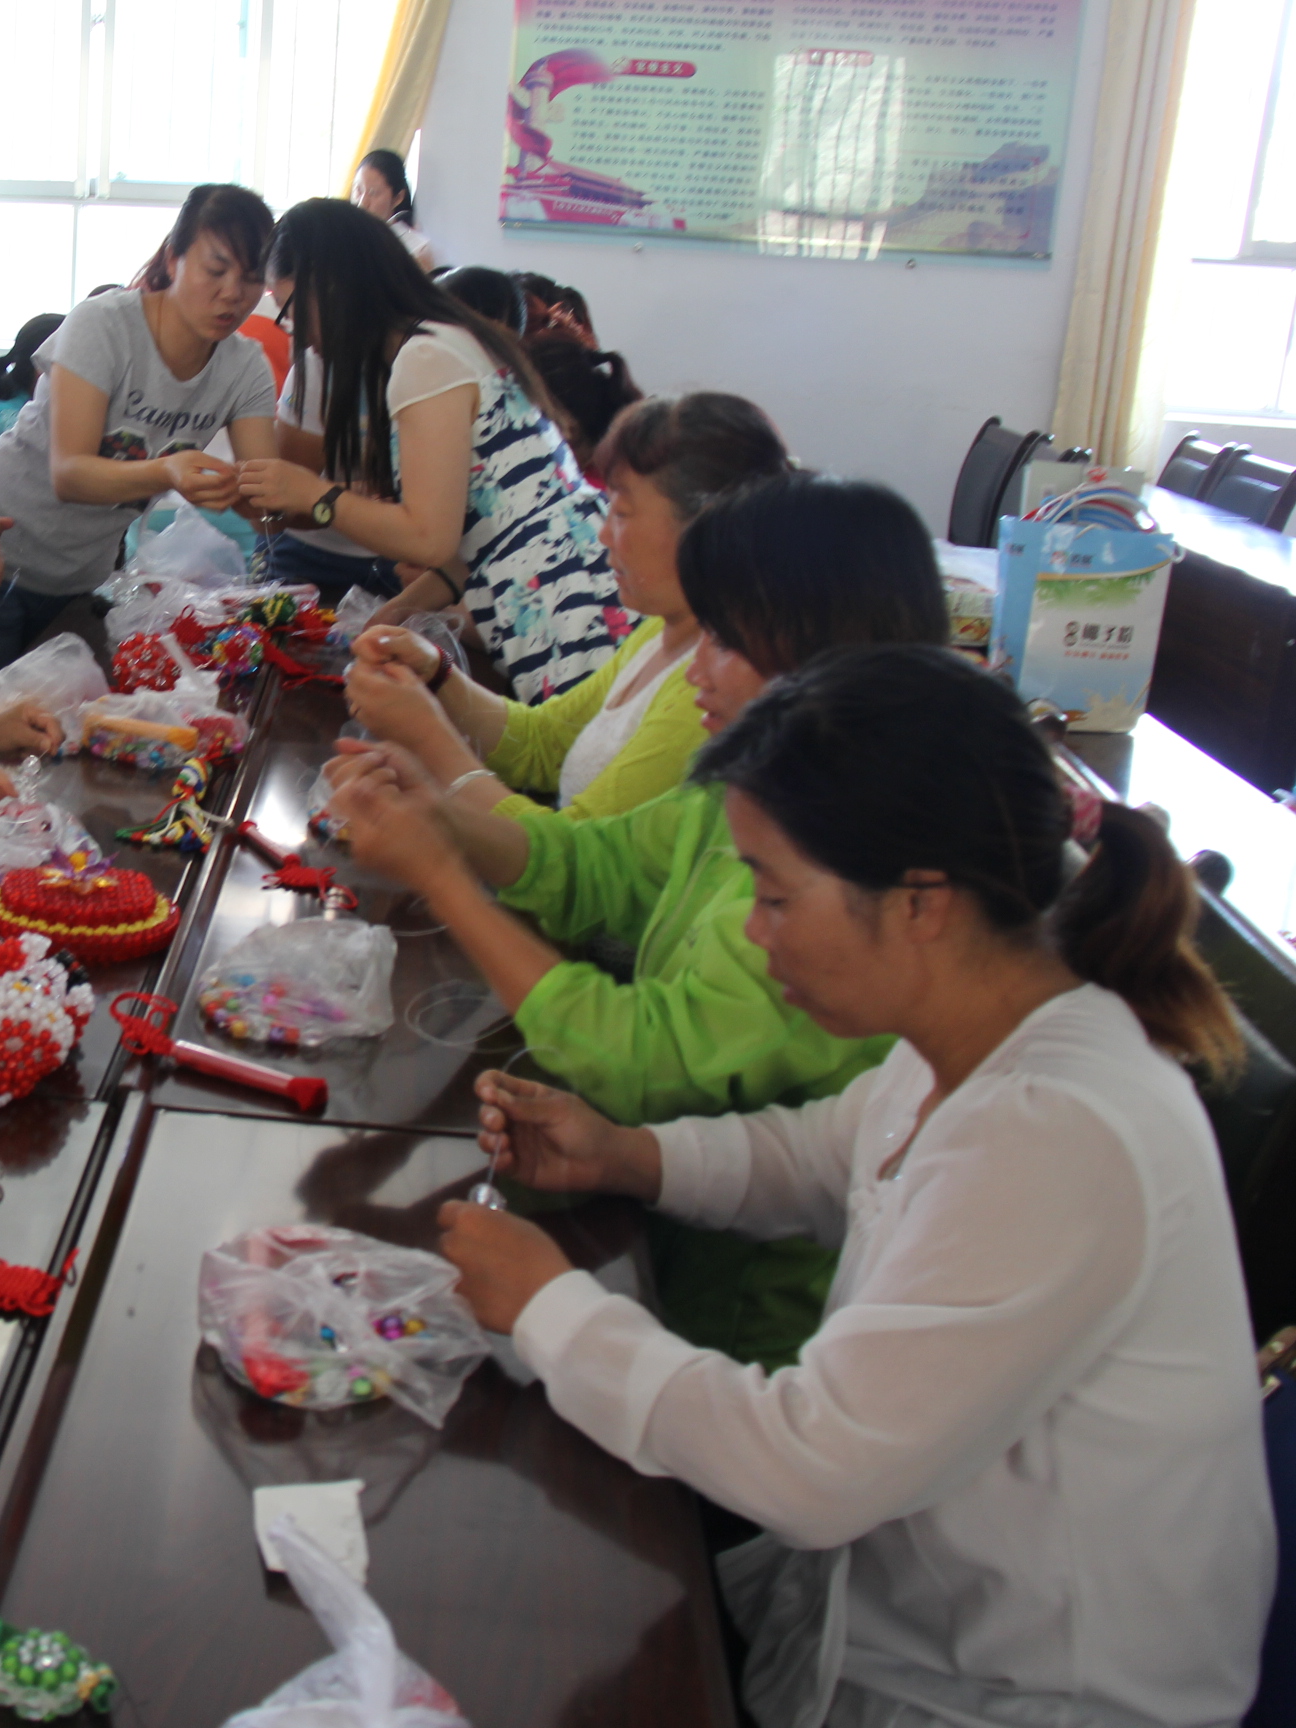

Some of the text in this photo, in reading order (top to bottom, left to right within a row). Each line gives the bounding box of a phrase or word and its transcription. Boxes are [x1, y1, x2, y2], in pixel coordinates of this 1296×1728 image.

[124, 390, 217, 438] Campus
[1082, 622, 1134, 644] 椰子粉
